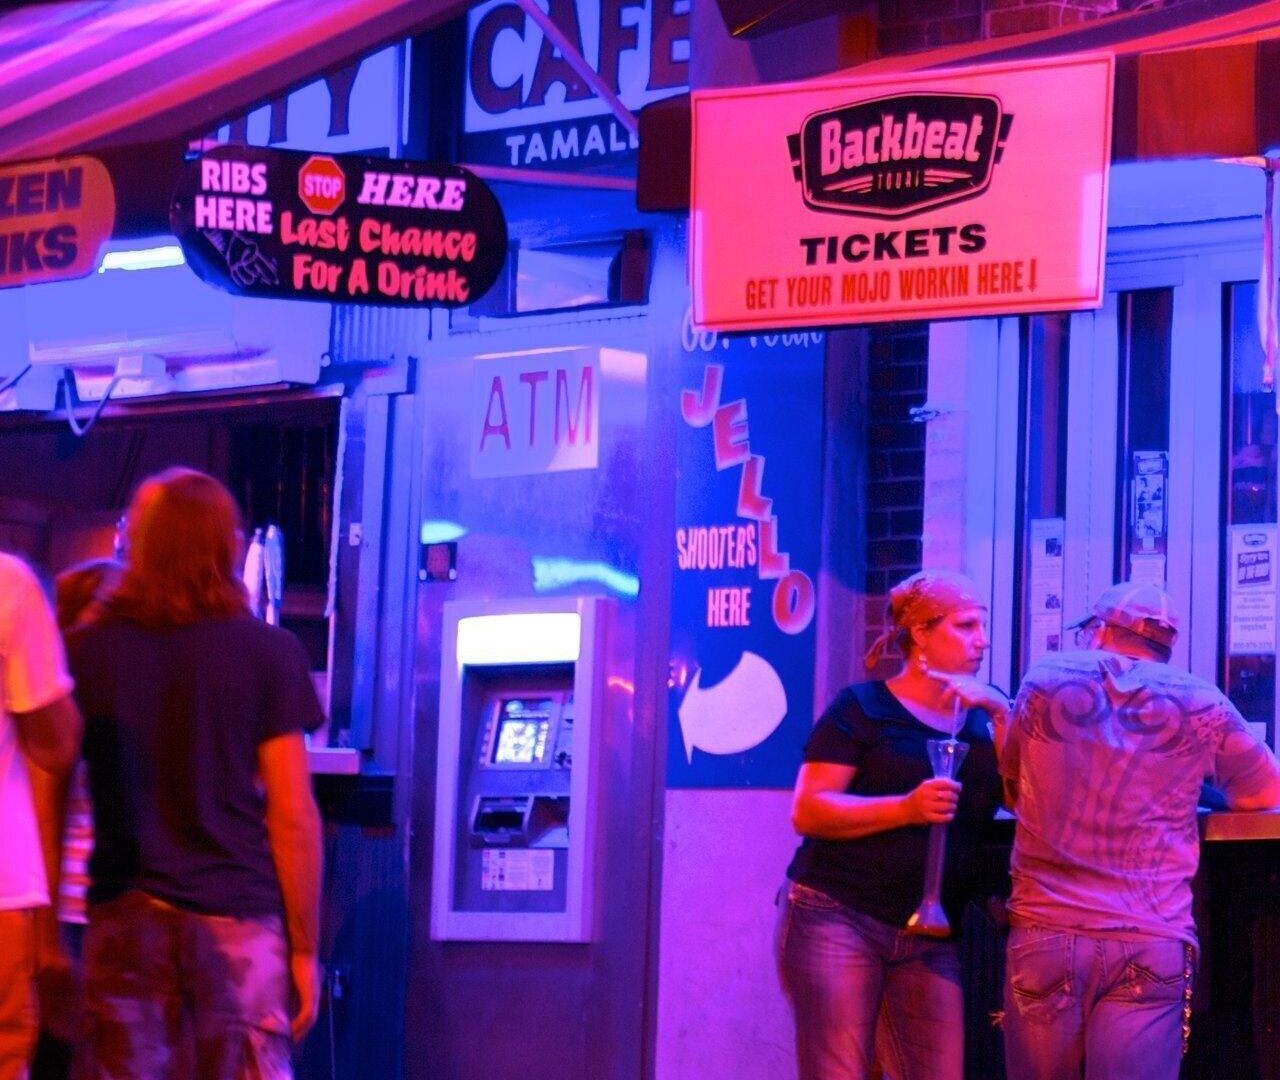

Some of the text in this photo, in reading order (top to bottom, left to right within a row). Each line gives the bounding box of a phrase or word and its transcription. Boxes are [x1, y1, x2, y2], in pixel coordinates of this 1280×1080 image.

[821, 113, 983, 176] Backbeat
[201, 158, 268, 196] RIBS
[304, 170, 467, 212] STOP HERE
[195, 195, 274, 235] HERE
[281, 210, 477, 262] Last Chance
[800, 223, 987, 267] TICKETS
[293, 253, 470, 303] For A Drink
[746, 261, 1023, 310] GET YOUR MOJO WORKIN HERE
[479, 366, 593, 452] ATM
[681, 365, 814, 635] JELLO
[676, 524, 757, 570] SHOOTERS
[707, 587, 752, 627] HERE
